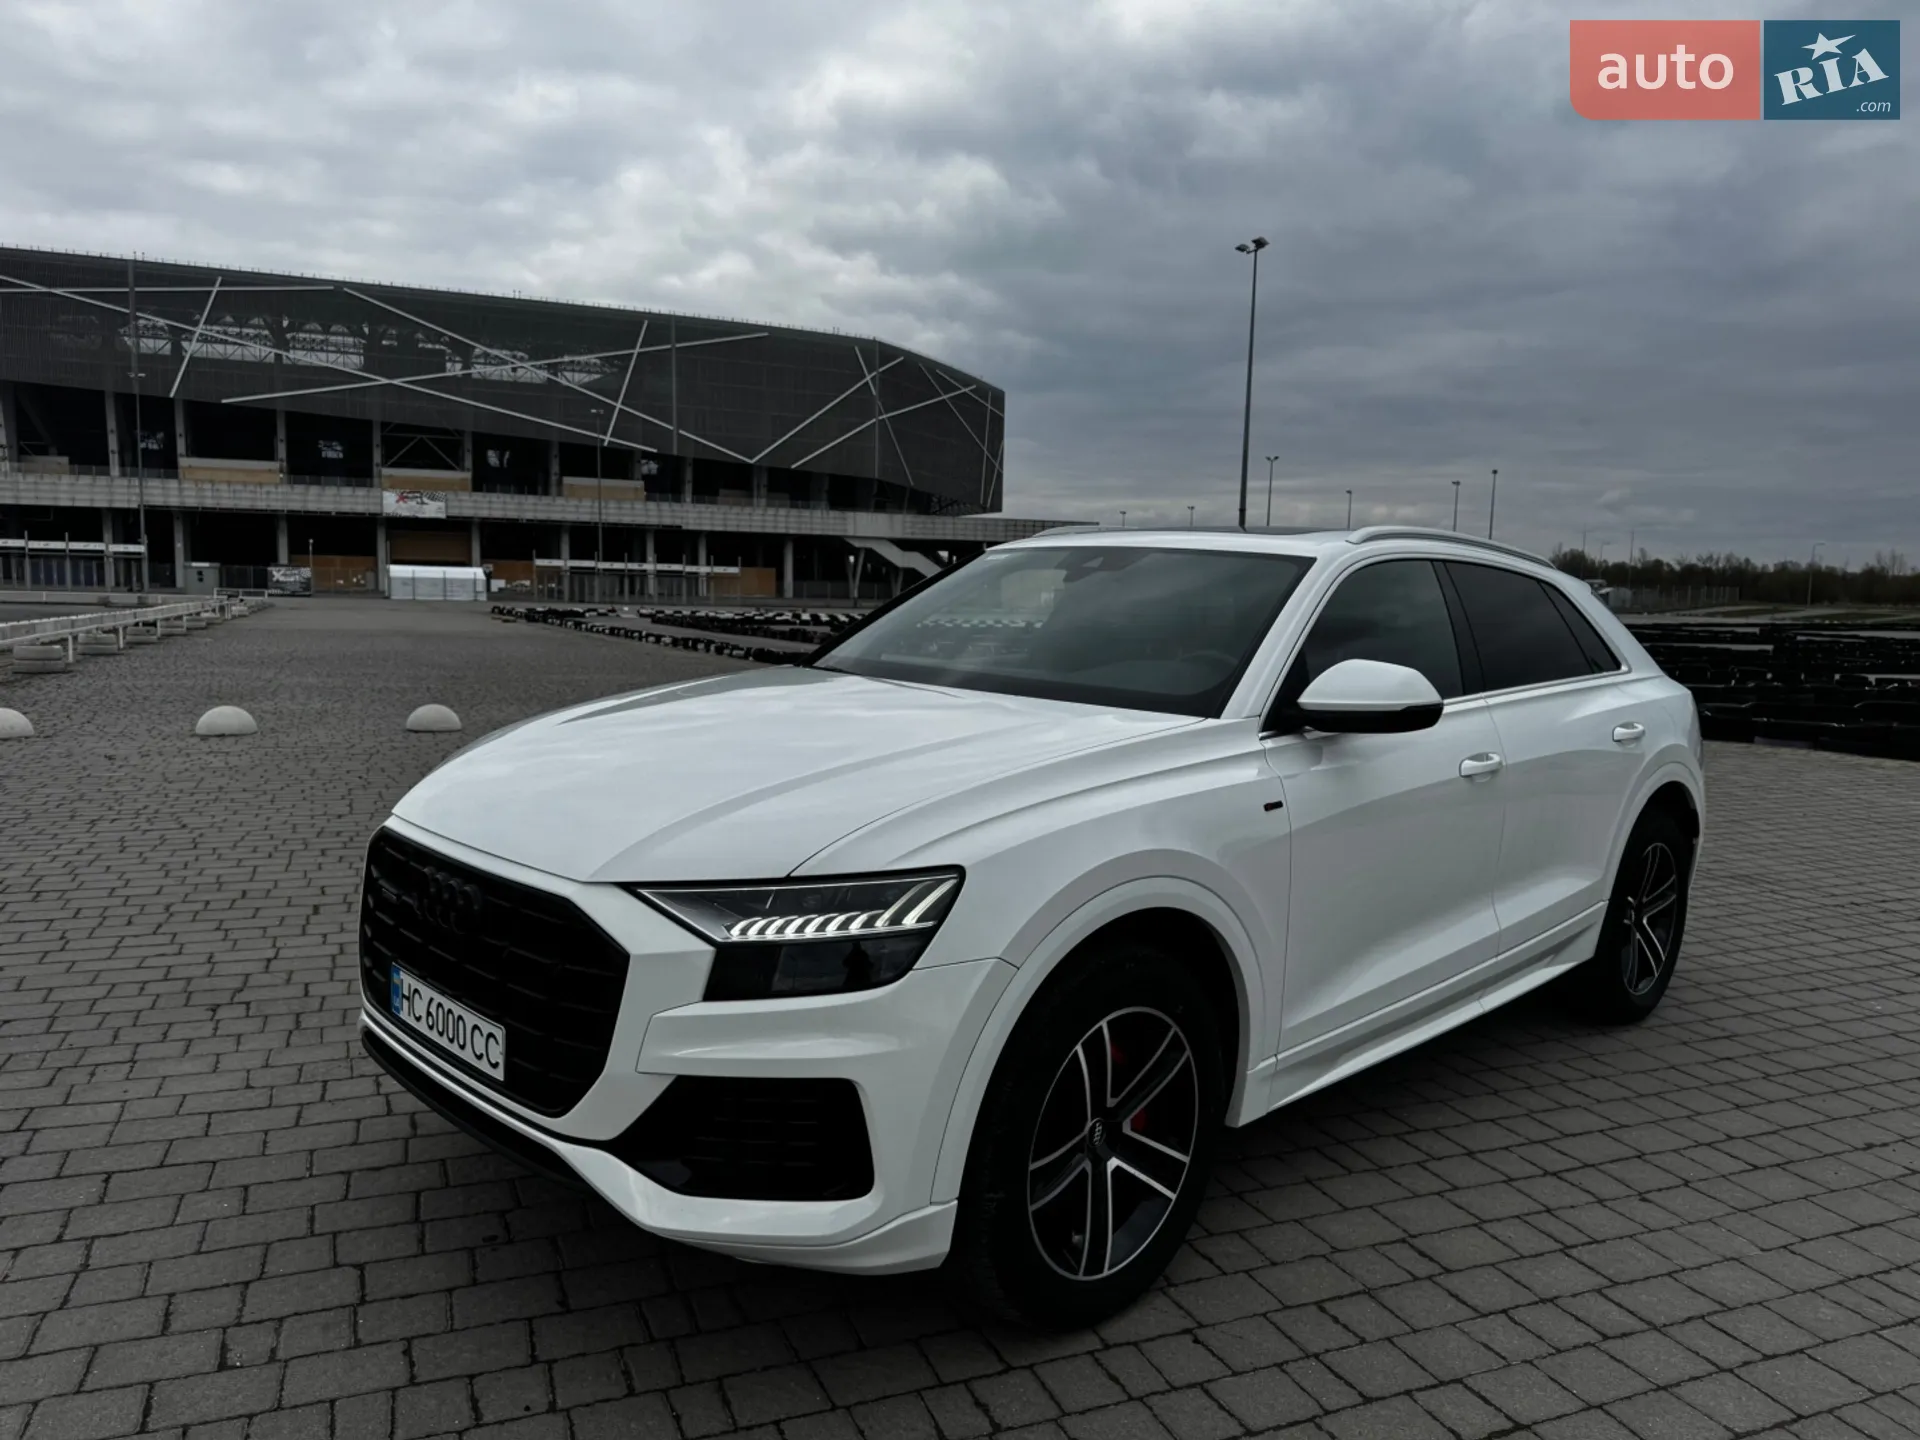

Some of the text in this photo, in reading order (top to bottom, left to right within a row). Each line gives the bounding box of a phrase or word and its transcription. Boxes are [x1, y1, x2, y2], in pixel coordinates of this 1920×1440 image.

[400, 978, 500, 1069] HC 6000 CC
